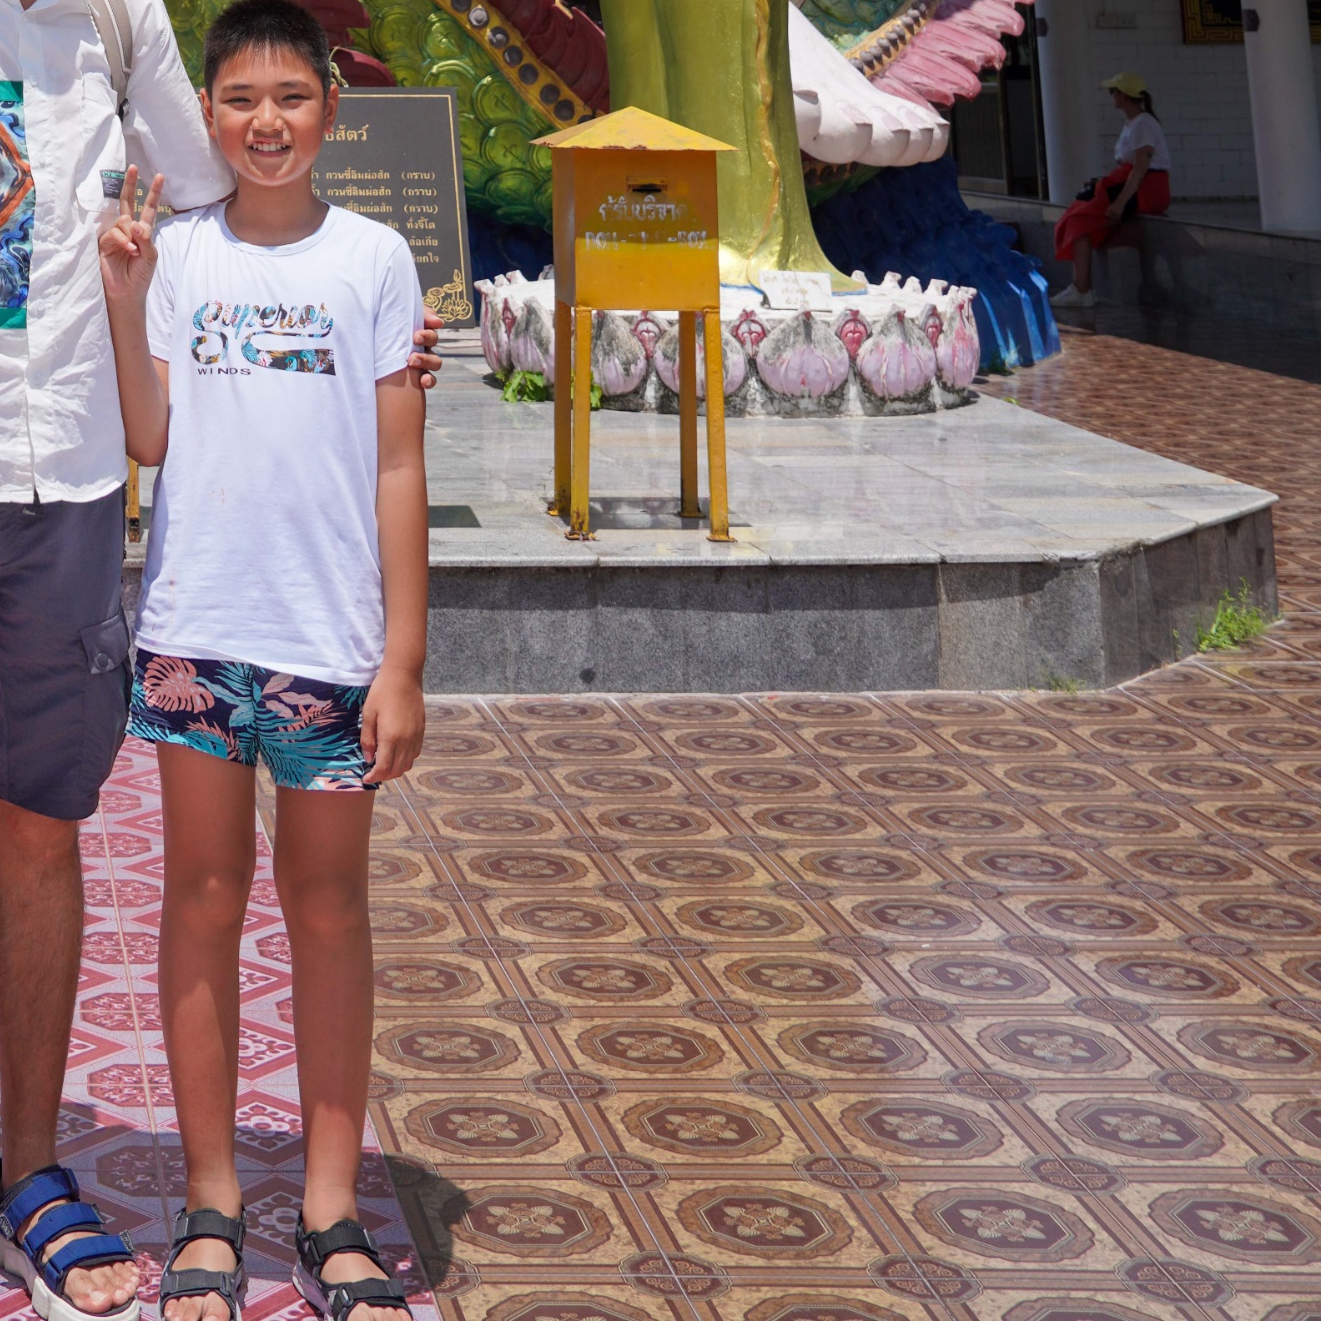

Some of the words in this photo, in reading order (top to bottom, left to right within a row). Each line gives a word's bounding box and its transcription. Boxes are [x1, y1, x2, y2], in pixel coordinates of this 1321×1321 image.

[401, 171, 436, 181] (กราบ)
[402, 187, 437, 197] (กราบ)
[403, 203, 439, 214] (กราบ)
[191, 299, 334, 366] Superior
[197, 367, 252, 376] WINDS
